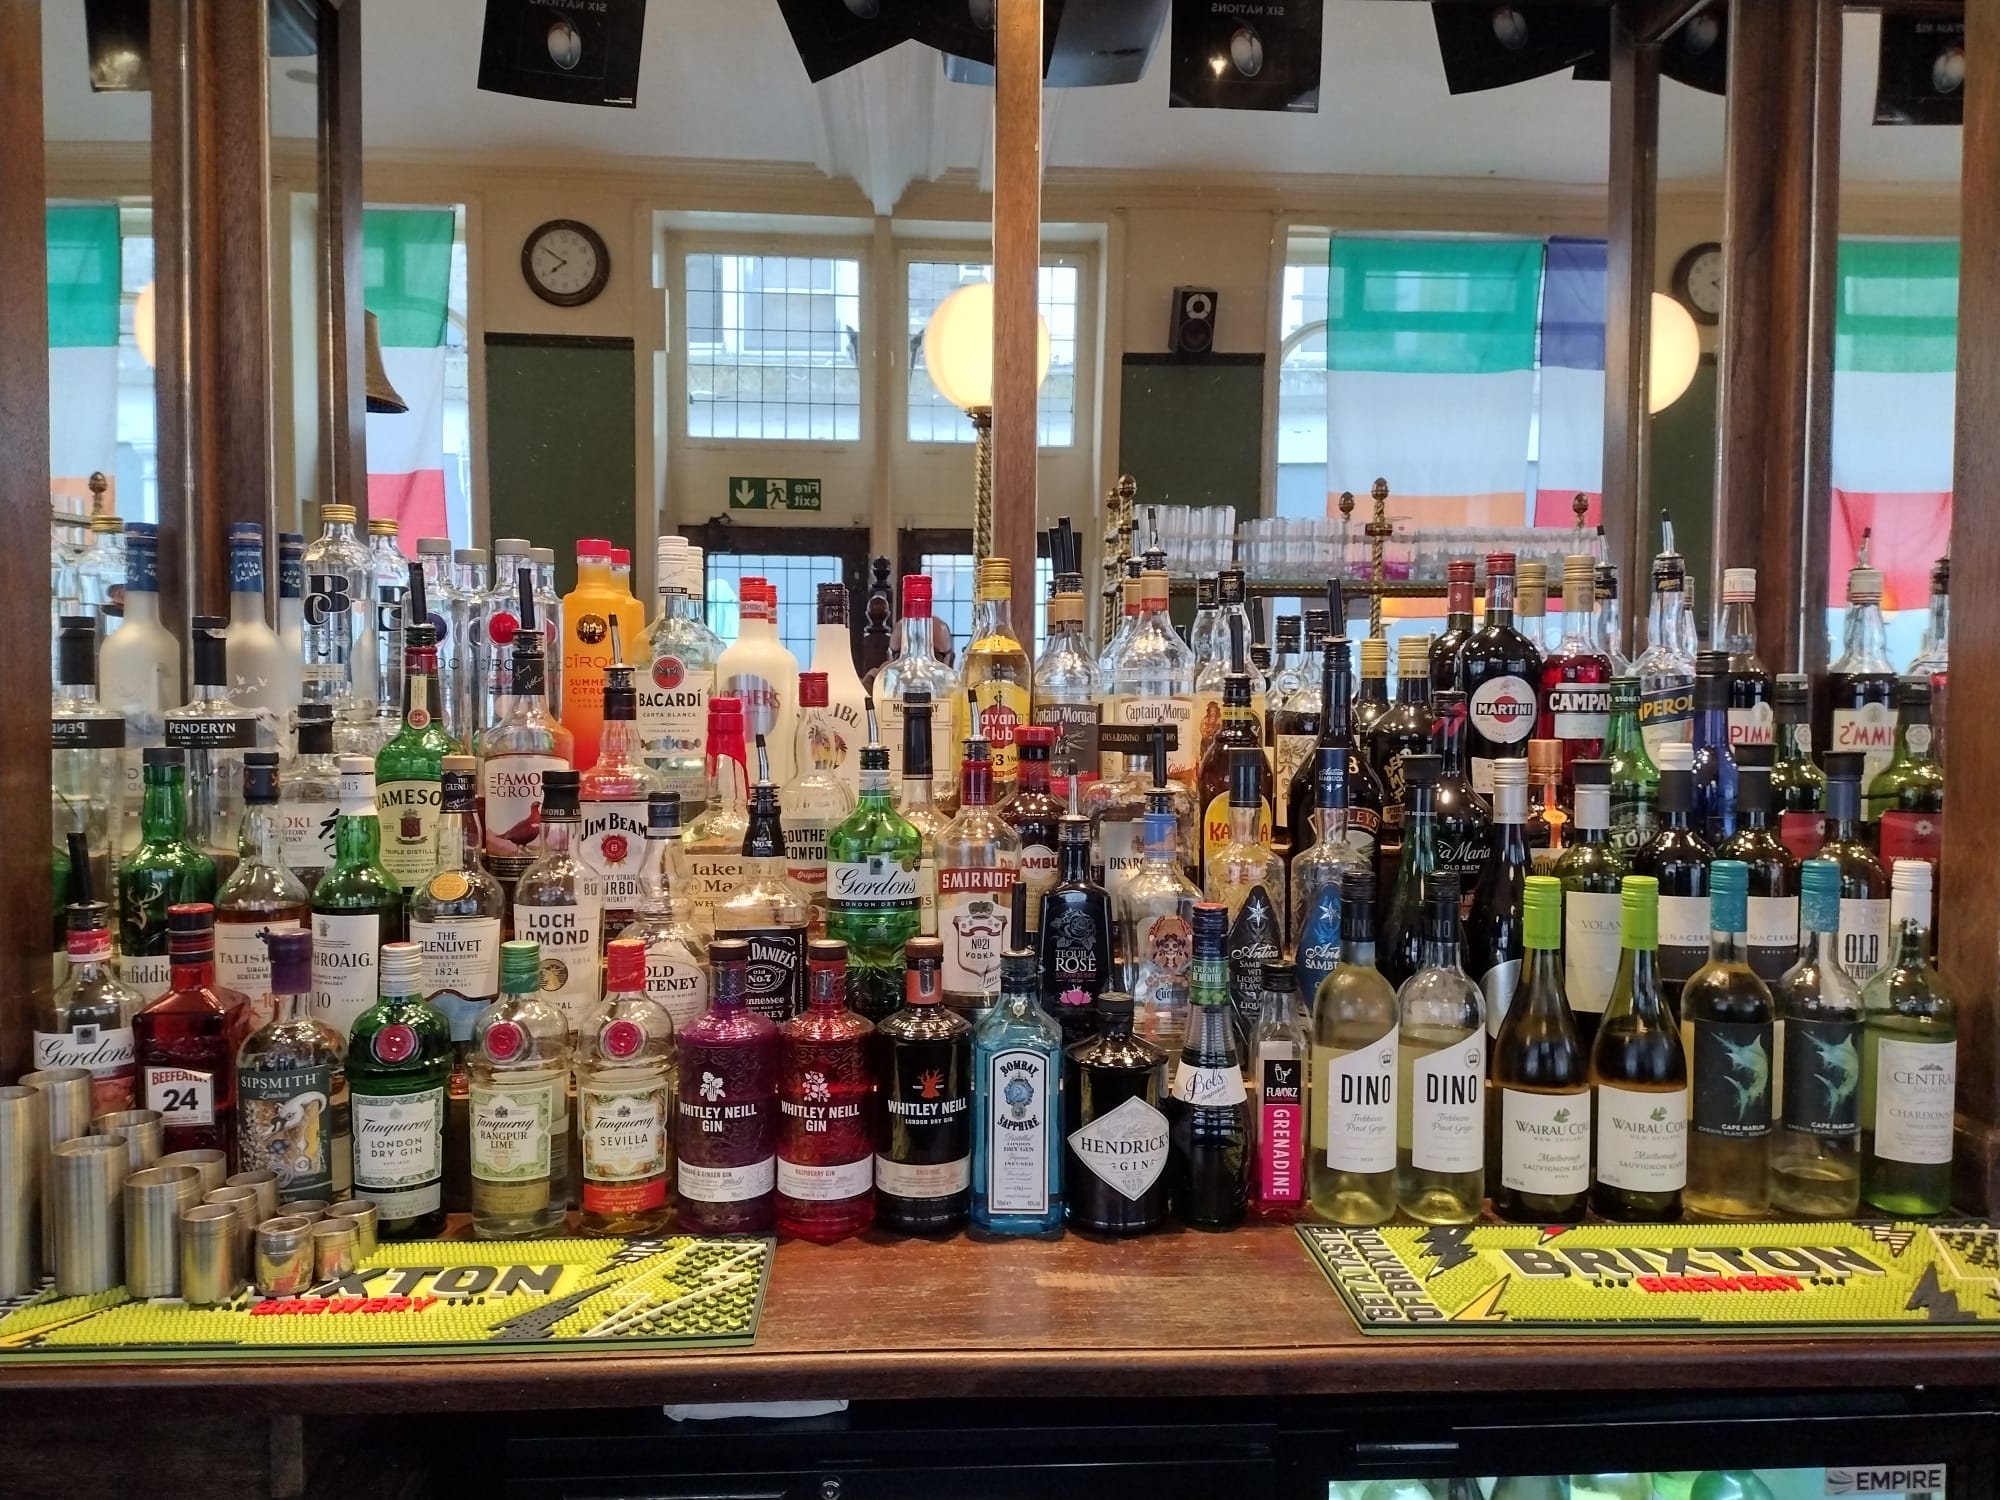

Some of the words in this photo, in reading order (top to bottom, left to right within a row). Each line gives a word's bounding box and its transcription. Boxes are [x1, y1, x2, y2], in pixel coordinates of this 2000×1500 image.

[569, 678, 604, 686] SUMME
[571, 687, 604, 695] CITRU
[639, 689, 702, 707] BACARDÍ
[1477, 703, 1532, 716] MARTINI
[1550, 693, 1611, 711] CAMPA
[981, 714, 1024, 725] avana
[1061, 706, 1097, 726] Morgan
[1126, 704, 1160, 722] Captain
[169, 722, 236, 734] PENDERYN
[1731, 726, 1772, 743] PIMM
[497, 772, 542, 786] FAMO
[376, 789, 442, 811] JAMESO
[496, 786, 542, 798] GROU
[1350, 809, 1379, 827] LEYS
[581, 818, 606, 841] JIM
[609, 812, 648, 840] BEAM
[1209, 821, 1268, 841] KAA
[783, 829, 826, 842] SOUTHE
[785, 846, 827, 860] COMFO
[1452, 839, 1490, 860] Maria
[1021, 857, 1058, 869] AMBU
[797, 871, 826, 880] Original
[836, 866, 917, 897] Gordon's
[942, 871, 1017, 889] SMIRNOFF
[840, 900, 876, 908] LONDON
[900, 899, 913, 907] GIN
[529, 914, 575, 929] LOCH
[436, 931, 458, 941] THE
[751, 942, 798, 970] DANIEL'S
[965, 951, 995, 959] VODKA
[1055, 949, 1096, 960] TEQUILA
[1231, 943, 1279, 960] Antica
[1845, 933, 1879, 963] OLD
[219, 952, 269, 965] TALISK
[1055, 957, 1097, 974] ROSE
[1239, 960, 1261, 968] SAMB
[434, 967, 459, 977] 1824
[644, 966, 674, 979] OLD
[747, 974, 772, 983] No.7
[1236, 975, 1261, 984] LIQUO
[1247, 968, 1261, 976] WIT
[646, 977, 698, 993] TENEY
[316, 991, 331, 1008] 10
[746, 996, 785, 1005] nnessee
[1240, 1001, 1259, 1010] LIQU
[38, 1037, 136, 1067] Gordon's
[999, 1060, 1040, 1078] BOMBAY
[240, 1073, 317, 1089] SIPSMITH
[1183, 1068, 1224, 1102] Bols
[1341, 1073, 1391, 1105] DINO
[1426, 1073, 1477, 1105] DINO
[162, 1088, 199, 1112] 24
[260, 1091, 290, 1100] London
[1266, 1087, 1298, 1098] FLAVORZ
[679, 1102, 722, 1120] WHITLEY
[724, 1103, 758, 1118] NEILL
[780, 1100, 825, 1120] WHITLEY
[828, 1103, 860, 1119] NEILL
[887, 1099, 938, 1117] WHITLEY
[941, 1097, 968, 1114] NEILL
[360, 1117, 433, 1137] Tanqueray
[475, 1114, 535, 1131] Tanqueray
[594, 1115, 655, 1130] Tanqueray
[702, 1119, 724, 1133] GIN
[805, 1119, 828, 1133] GIN
[997, 1113, 1040, 1131] SAPPHIRE
[1515, 1119, 1567, 1136] WAIRAU
[1568, 1122, 1590, 1135] CO
[1612, 1117, 1664, 1134] WAIRAU
[1721, 1123, 1741, 1131] CAPE
[1810, 1121, 1829, 1130] CAPE
[480, 1130, 528, 1141] RANGPUR
[599, 1133, 649, 1147] SEVILLA
[1722, 1129, 1745, 1137] BLANC
[370, 1136, 423, 1149] LONDON
[490, 1139, 514, 1150] LIME
[371, 1147, 394, 1158] DRY
[400, 1145, 423, 1157] GIN
[1272, 1107, 1290, 1197] GRENADINE
[1120, 1159, 1149, 1171] GIN
[1523, 1163, 1571, 1171] SAUVIGNON
[1618, 1160, 1667, 1170] SAUVIGNON
[1310, 1227, 1369, 1272] TASTE
[1346, 1228, 1424, 1296] BRIXTON
[1501, 1246, 1888, 1279] BRIXTON
[301, 1263, 564, 1300] XTON
[1636, 1275, 1804, 1295] BREWERY
[250, 1295, 438, 1317] BREWERY
[1349, 1286, 1404, 1321] GET
[1395, 1295, 1445, 1321] OF
[1854, 1470, 1942, 1492] EMPIRE
